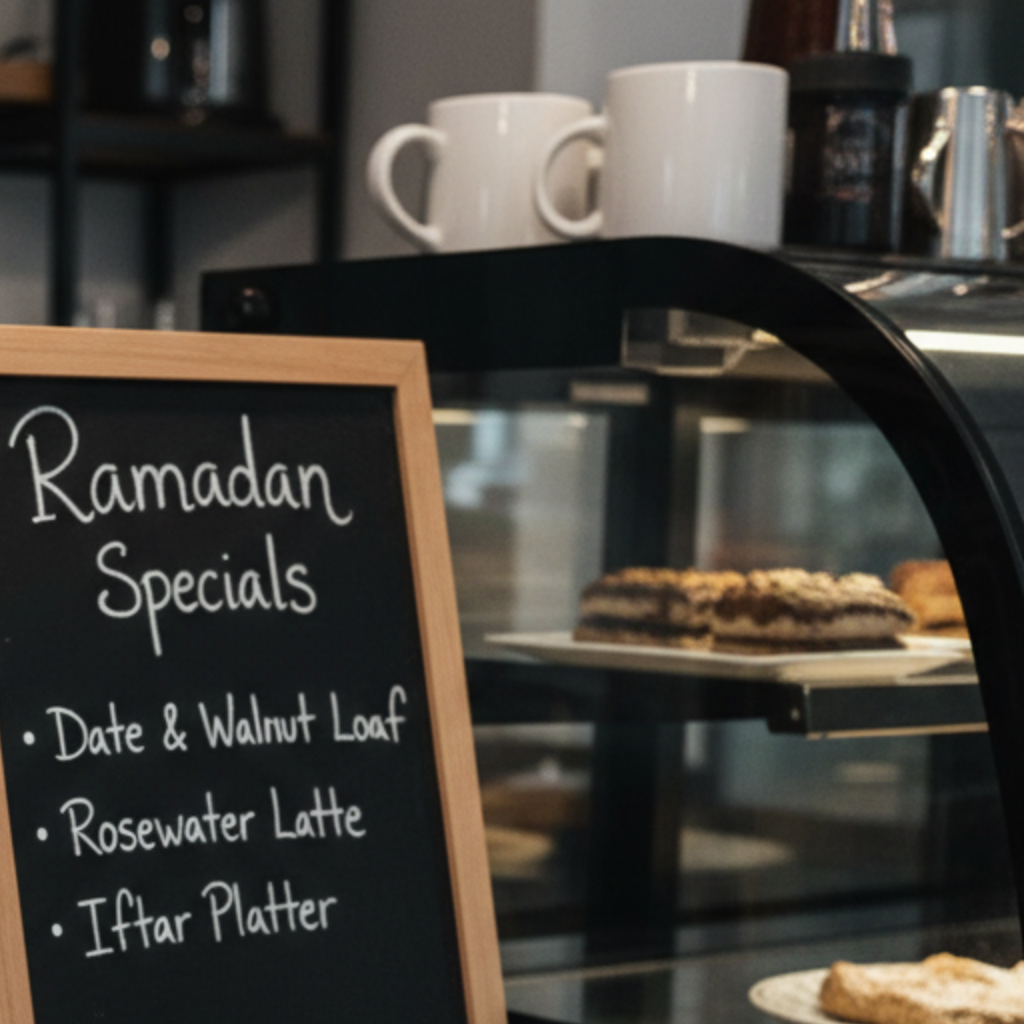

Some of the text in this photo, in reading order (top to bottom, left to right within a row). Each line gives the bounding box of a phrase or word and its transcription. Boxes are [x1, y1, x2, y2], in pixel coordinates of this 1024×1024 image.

[7, 405, 353, 526] Ramadan
[95, 532, 317, 657] Specials
[45, 685, 407, 762] Date & Walnut Loaf
[59, 786, 367, 857] Rosewater Latte
[76, 879, 339, 958] Iftar Platter
